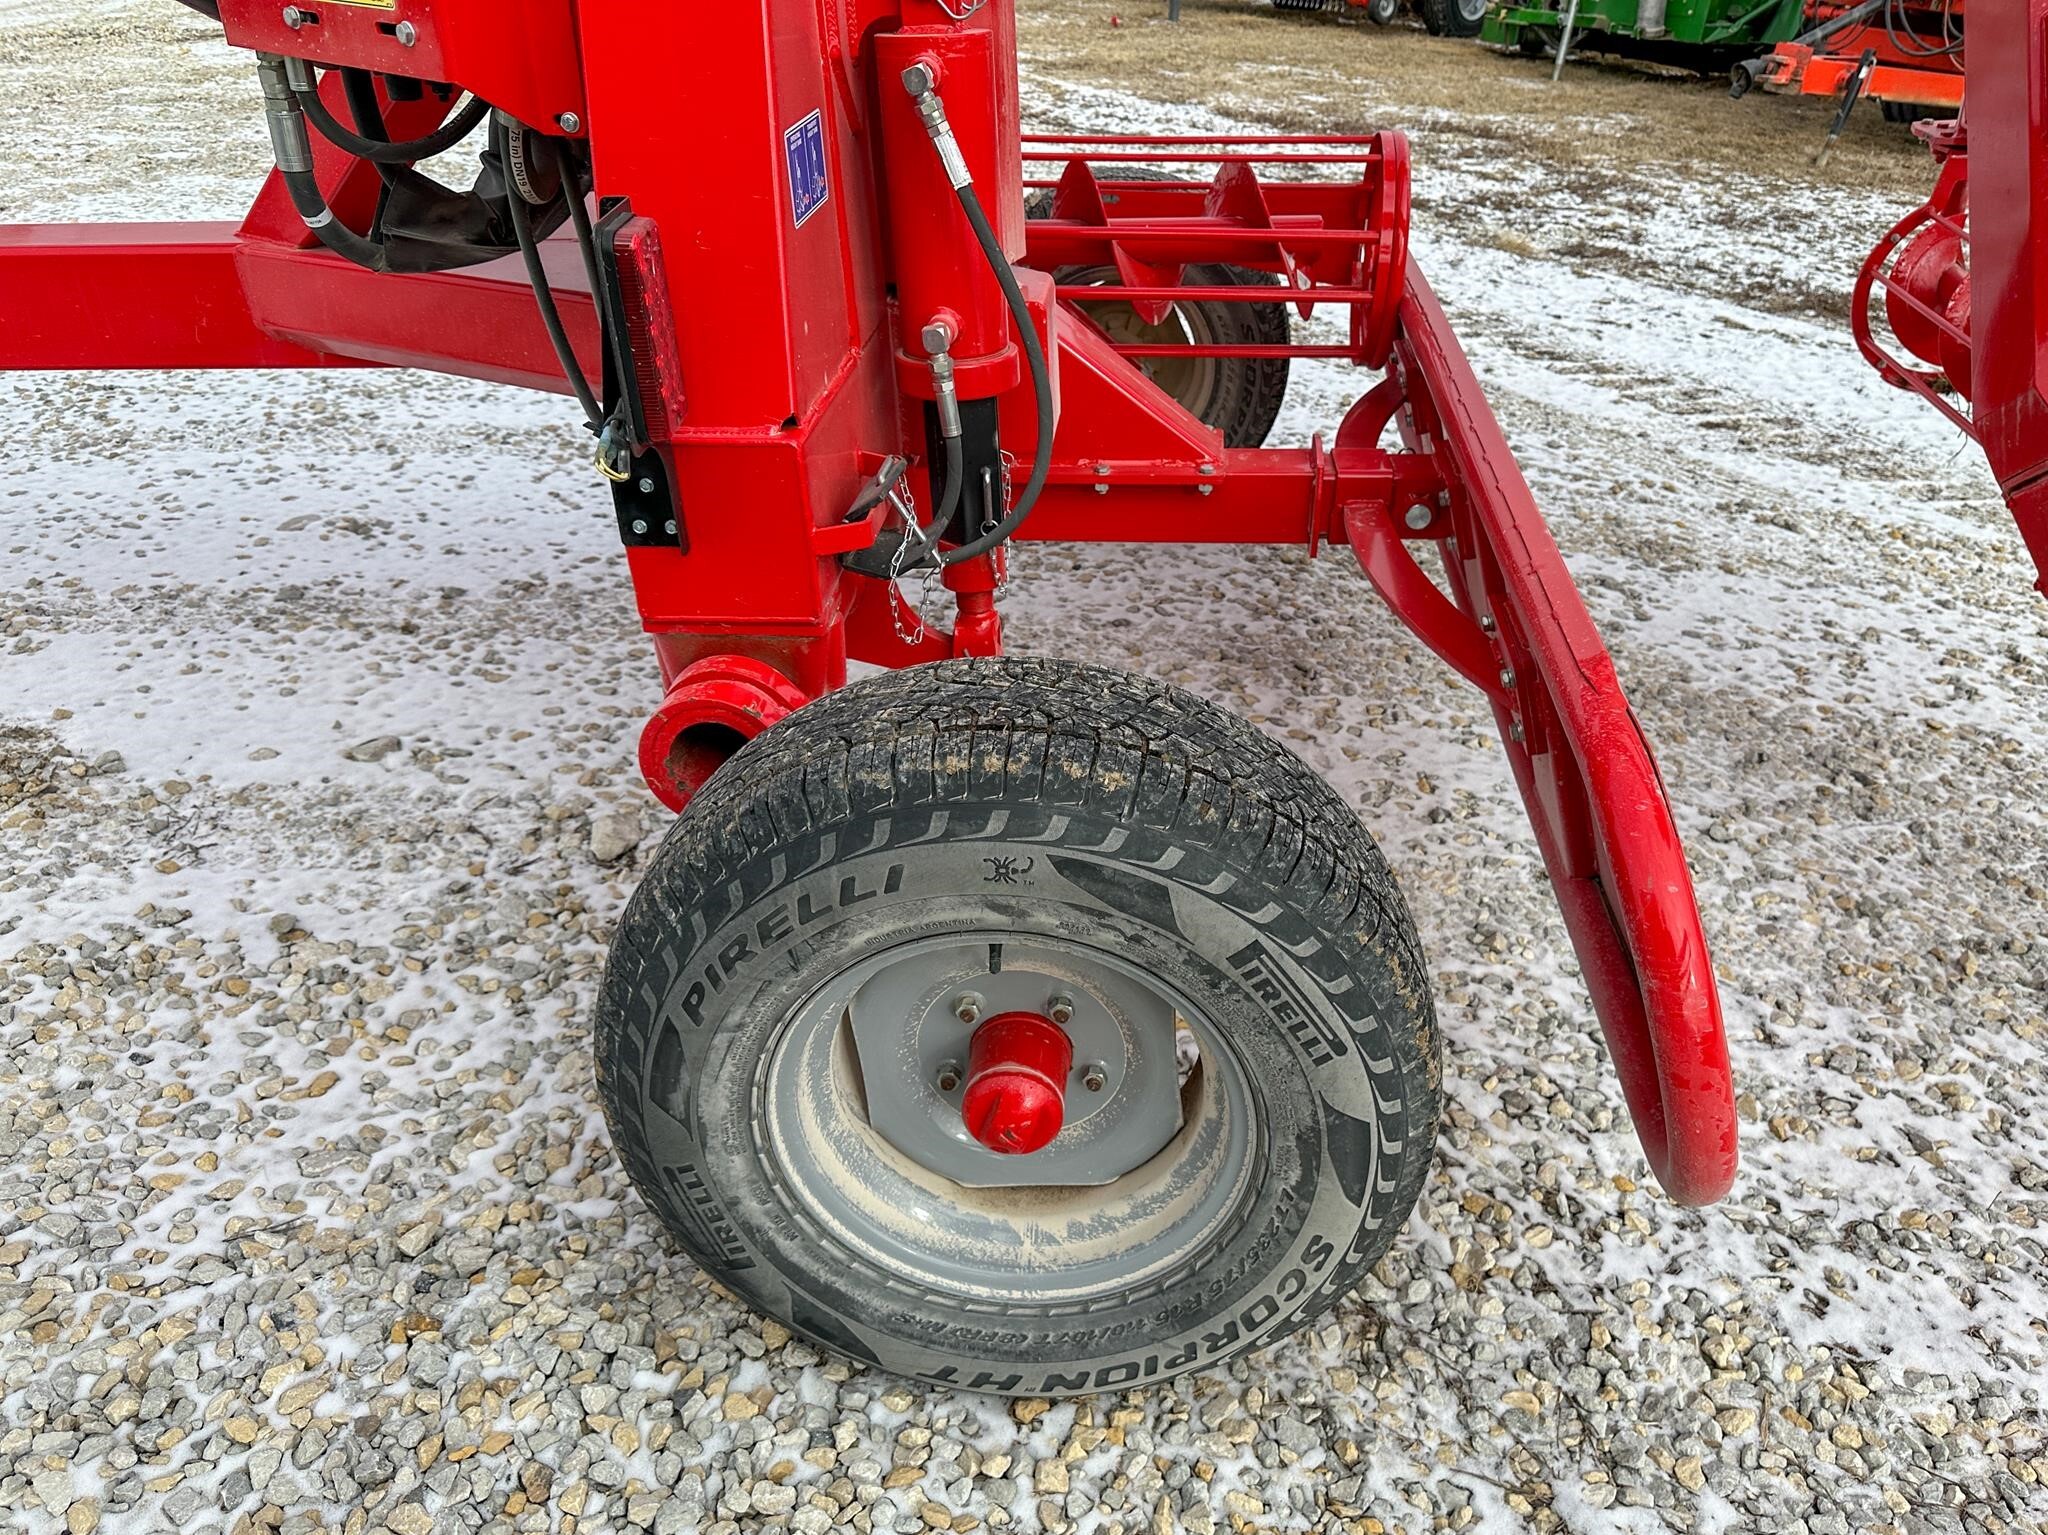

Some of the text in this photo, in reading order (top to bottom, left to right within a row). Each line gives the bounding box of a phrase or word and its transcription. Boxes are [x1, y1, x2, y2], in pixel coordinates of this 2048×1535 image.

[514, 161, 528, 187] DN19
[681, 863, 905, 1028] PIRELLI
[919, 919, 977, 932] ARGENTINA
[1226, 939, 1348, 1067] PIRELLI
[664, 1163, 758, 1271] PIRELLI
[1040, 1235, 1334, 1393] SCORPION
[915, 1365, 1024, 1392] HT
